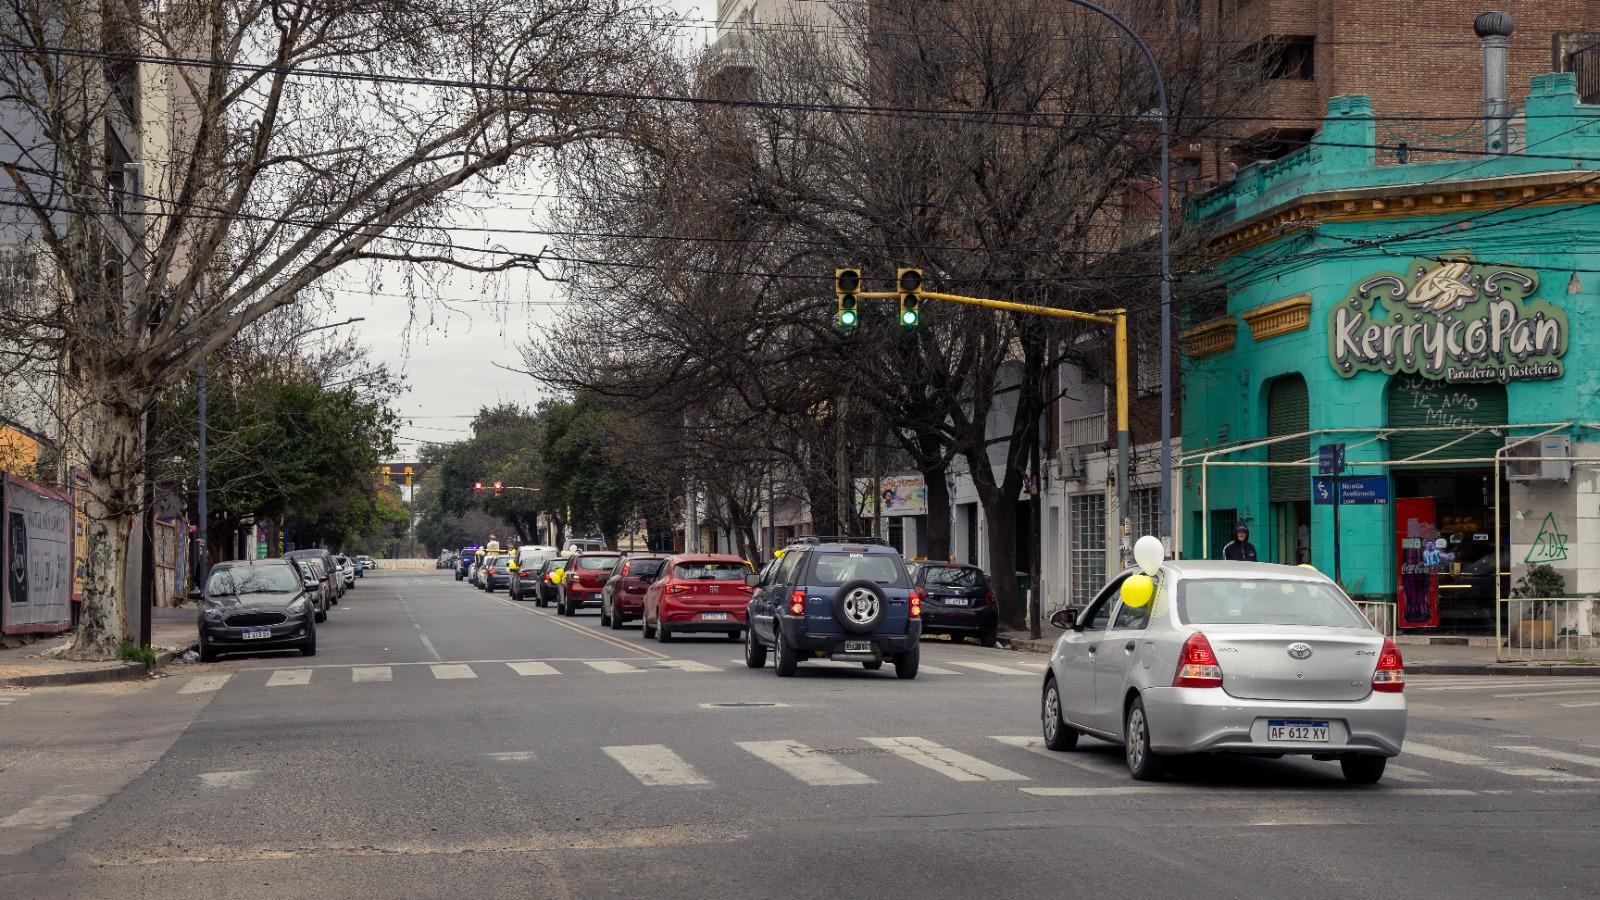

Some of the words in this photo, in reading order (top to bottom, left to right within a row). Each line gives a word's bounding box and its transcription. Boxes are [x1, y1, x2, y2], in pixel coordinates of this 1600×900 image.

[1447, 365, 1496, 380] Panadería
[1499, 367, 1506, 380] y
[1508, 360, 1559, 378] Pastelería
[1271, 727, 1284, 738] AF
[1289, 727, 1309, 739] 612
[1313, 728, 1326, 739] XY
